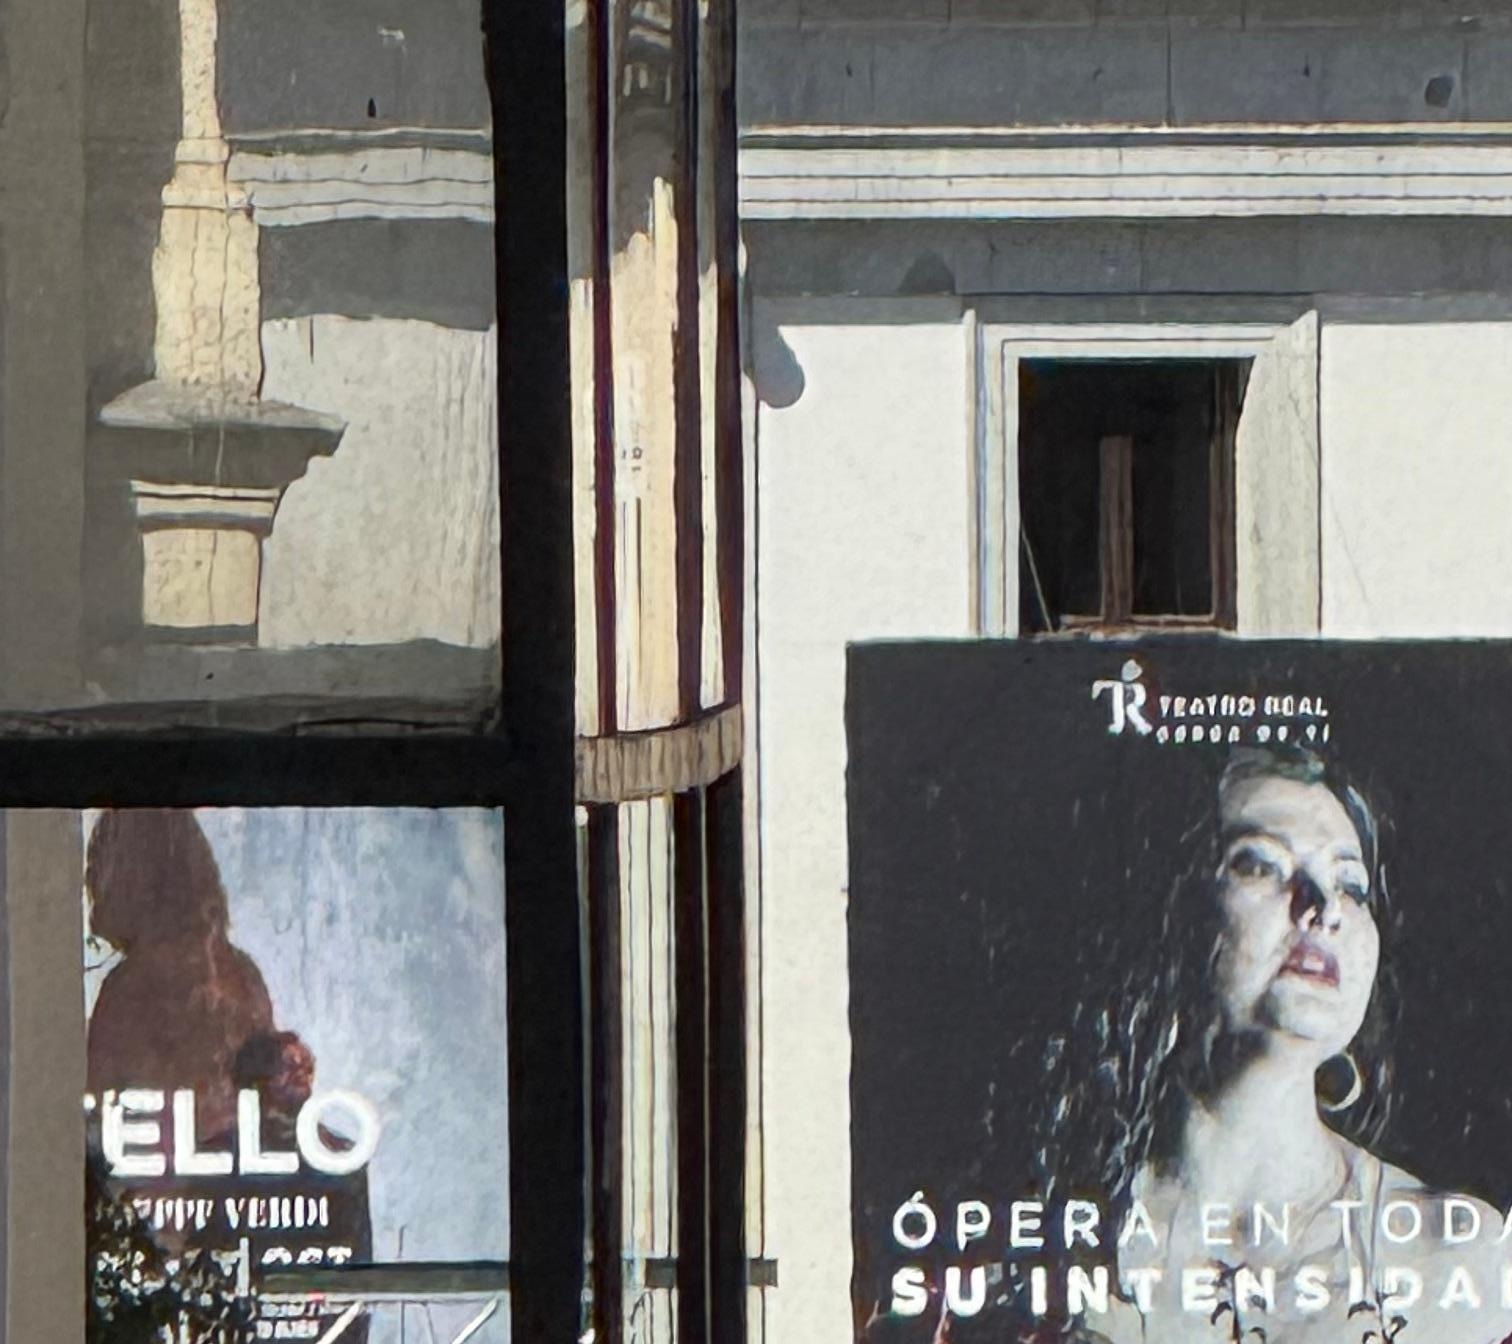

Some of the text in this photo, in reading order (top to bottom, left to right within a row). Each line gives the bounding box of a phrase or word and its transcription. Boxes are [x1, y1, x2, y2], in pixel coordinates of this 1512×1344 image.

[1159, 694, 1256, 718] TEATRO
[83, 1088, 380, 1176] ELLO
[224, 1195, 329, 1230] VERDI
[892, 1190, 1158, 1251] ÓPERA
[1201, 1202, 1291, 1247] EN
[891, 1265, 987, 1318] SU
